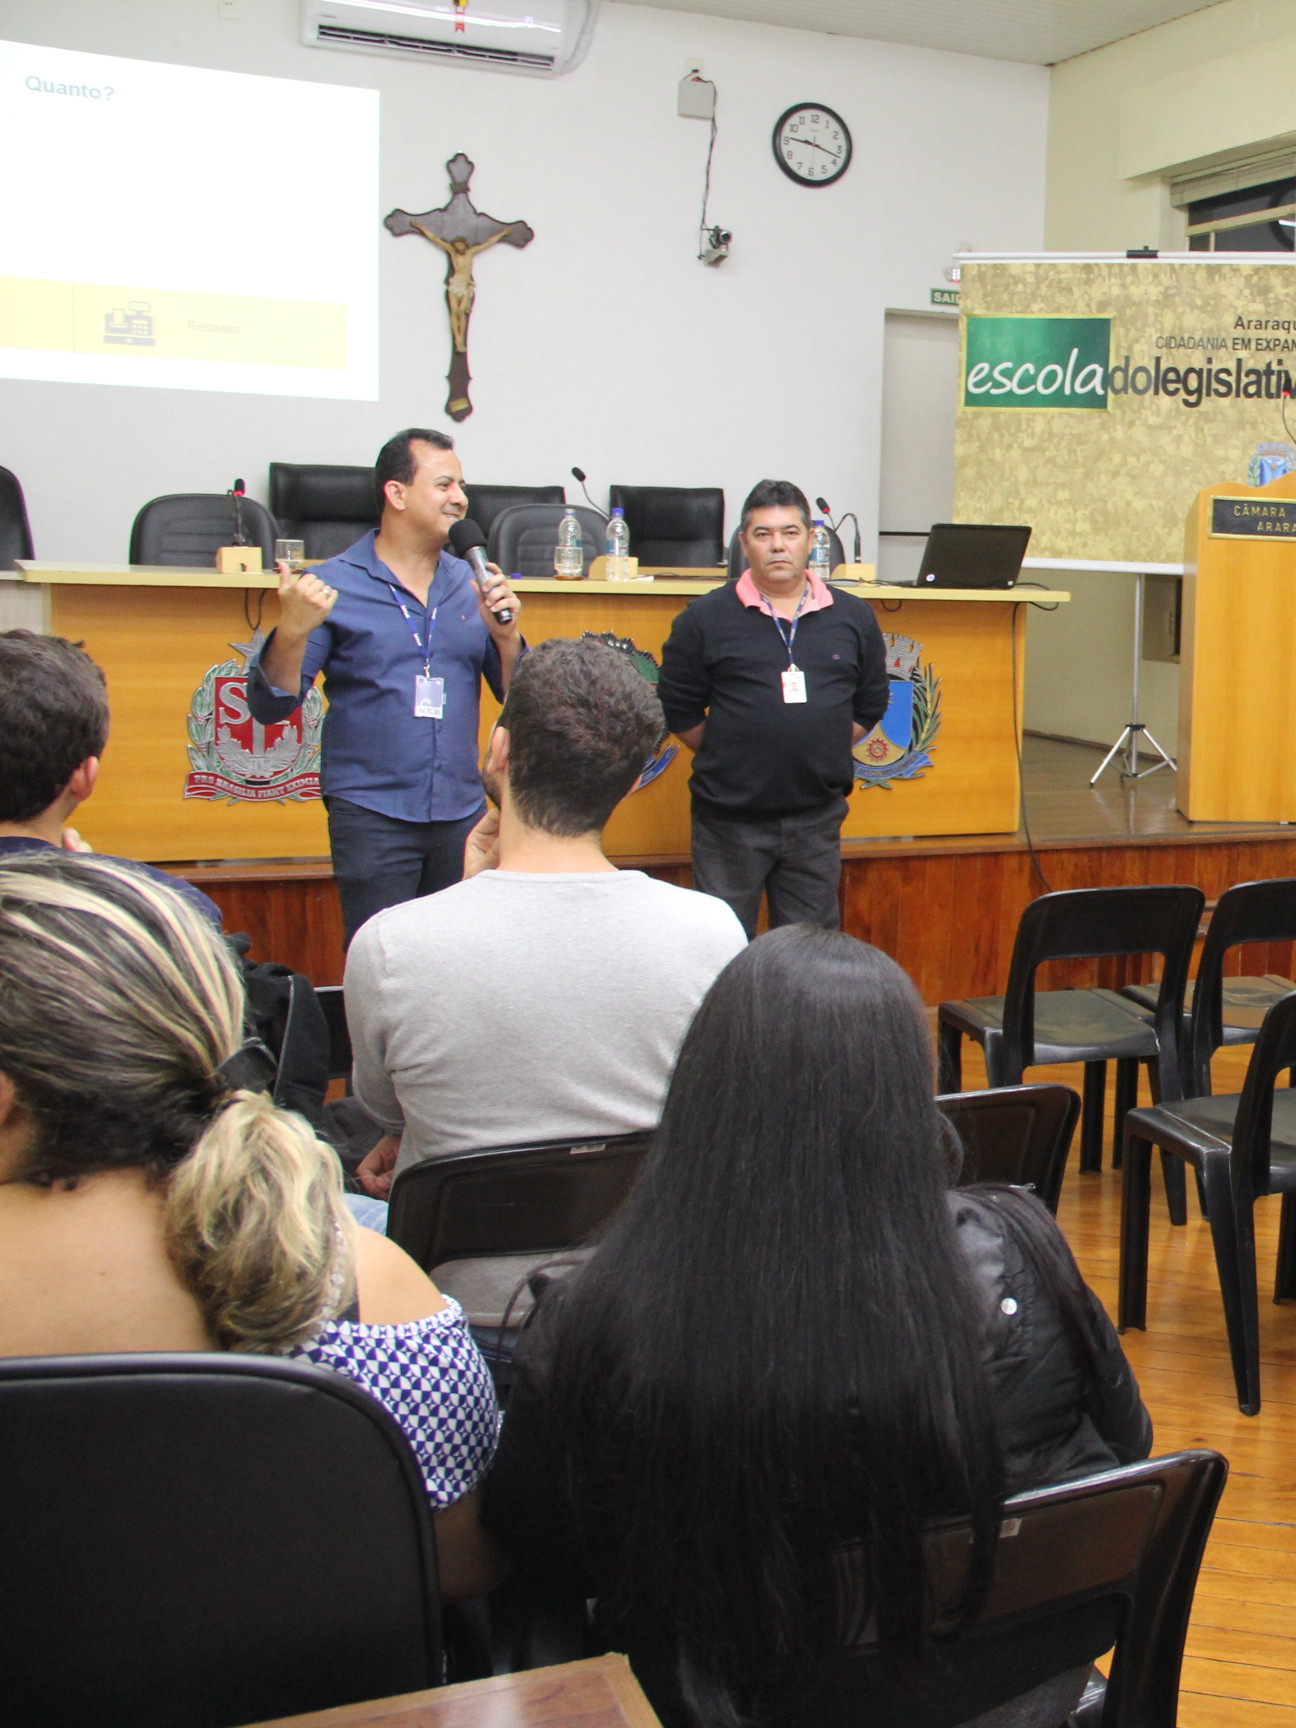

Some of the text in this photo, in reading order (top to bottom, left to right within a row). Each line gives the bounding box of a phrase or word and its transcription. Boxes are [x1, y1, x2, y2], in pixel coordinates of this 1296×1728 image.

[25, 75, 115, 101] Quanto?
[187, 320, 241, 335] Receitas
[1155, 336, 1228, 350] CIDADANIA
[1232, 338, 1254, 351] EM
[967, 347, 1105, 396] escola
